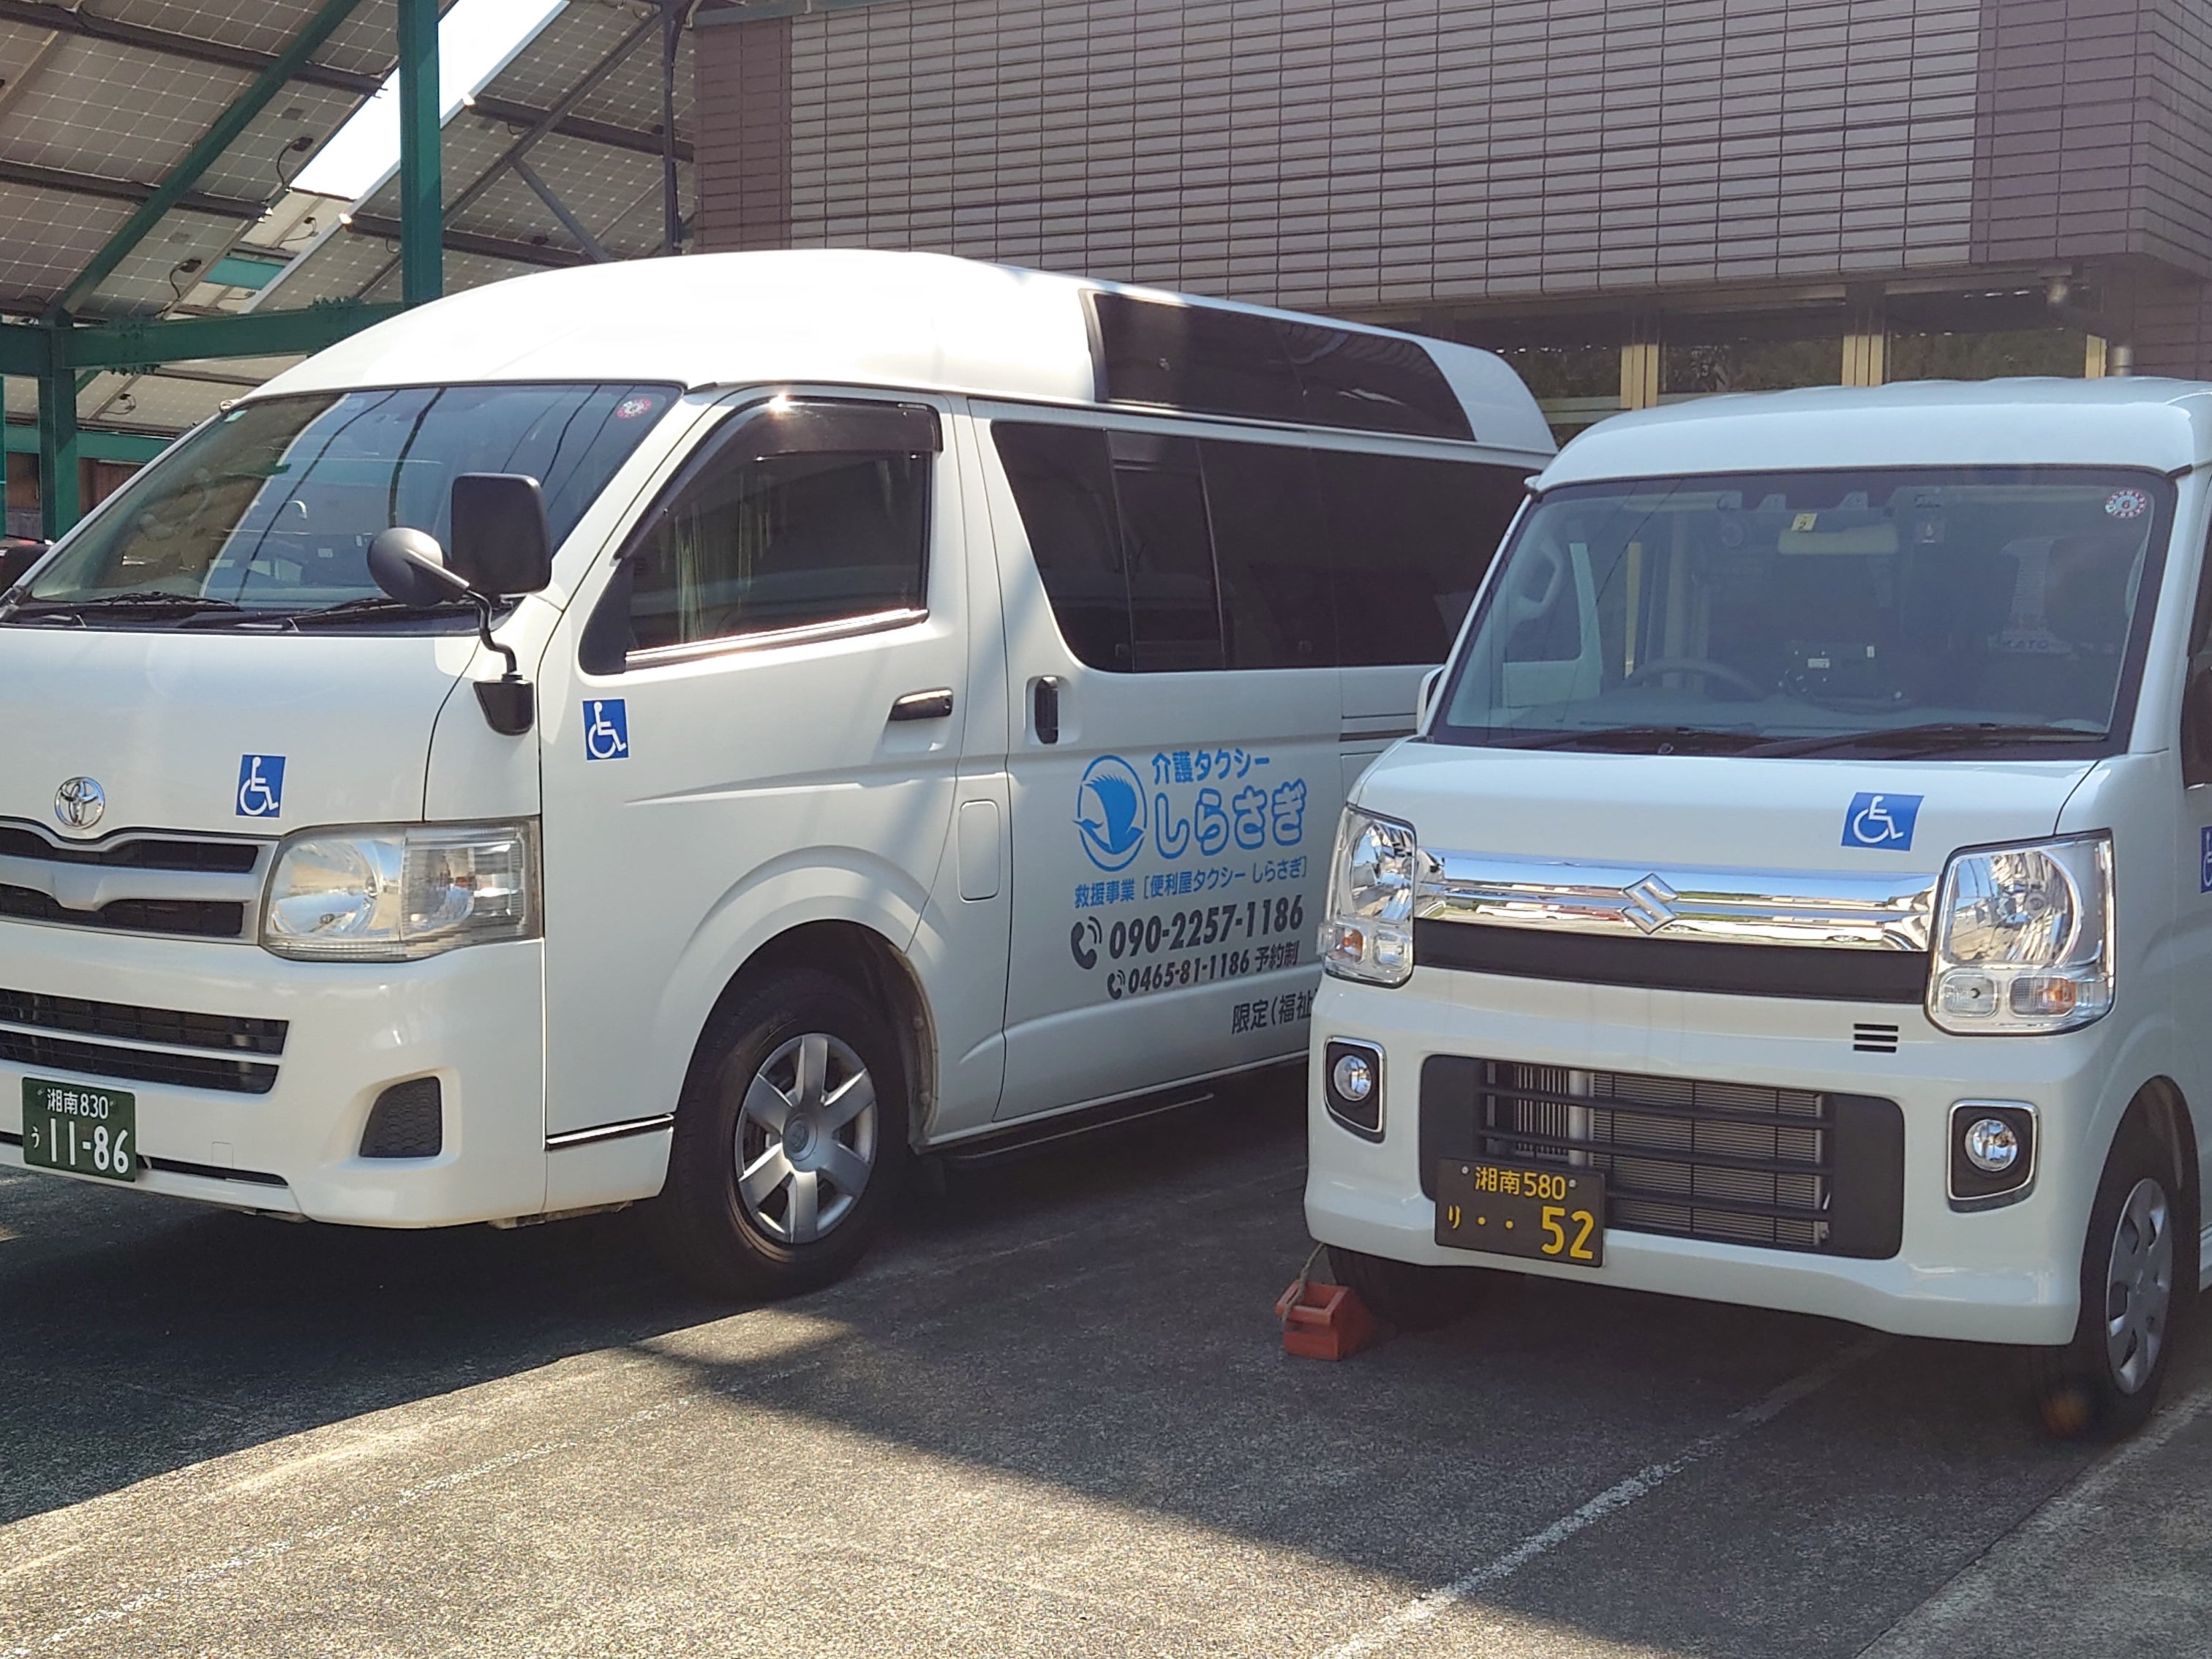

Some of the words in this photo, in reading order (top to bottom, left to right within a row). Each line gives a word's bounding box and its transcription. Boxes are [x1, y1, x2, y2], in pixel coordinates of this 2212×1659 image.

[1151, 748, 1271, 786] 介護タクシー
[1154, 778, 1308, 860] しらさぎ
[1074, 879, 1135, 908] 救援事業
[1109, 894, 1304, 960] 090-2257-1186
[1127, 949, 1250, 995] 0465-81-1186
[1254, 939, 1301, 974] 予約制
[1231, 988, 1318, 1035] 限定(福祉
[31, 1125, 40, 1149] う
[50, 1117, 129, 1174] 11-86
[1448, 1205, 1462, 1230] り
